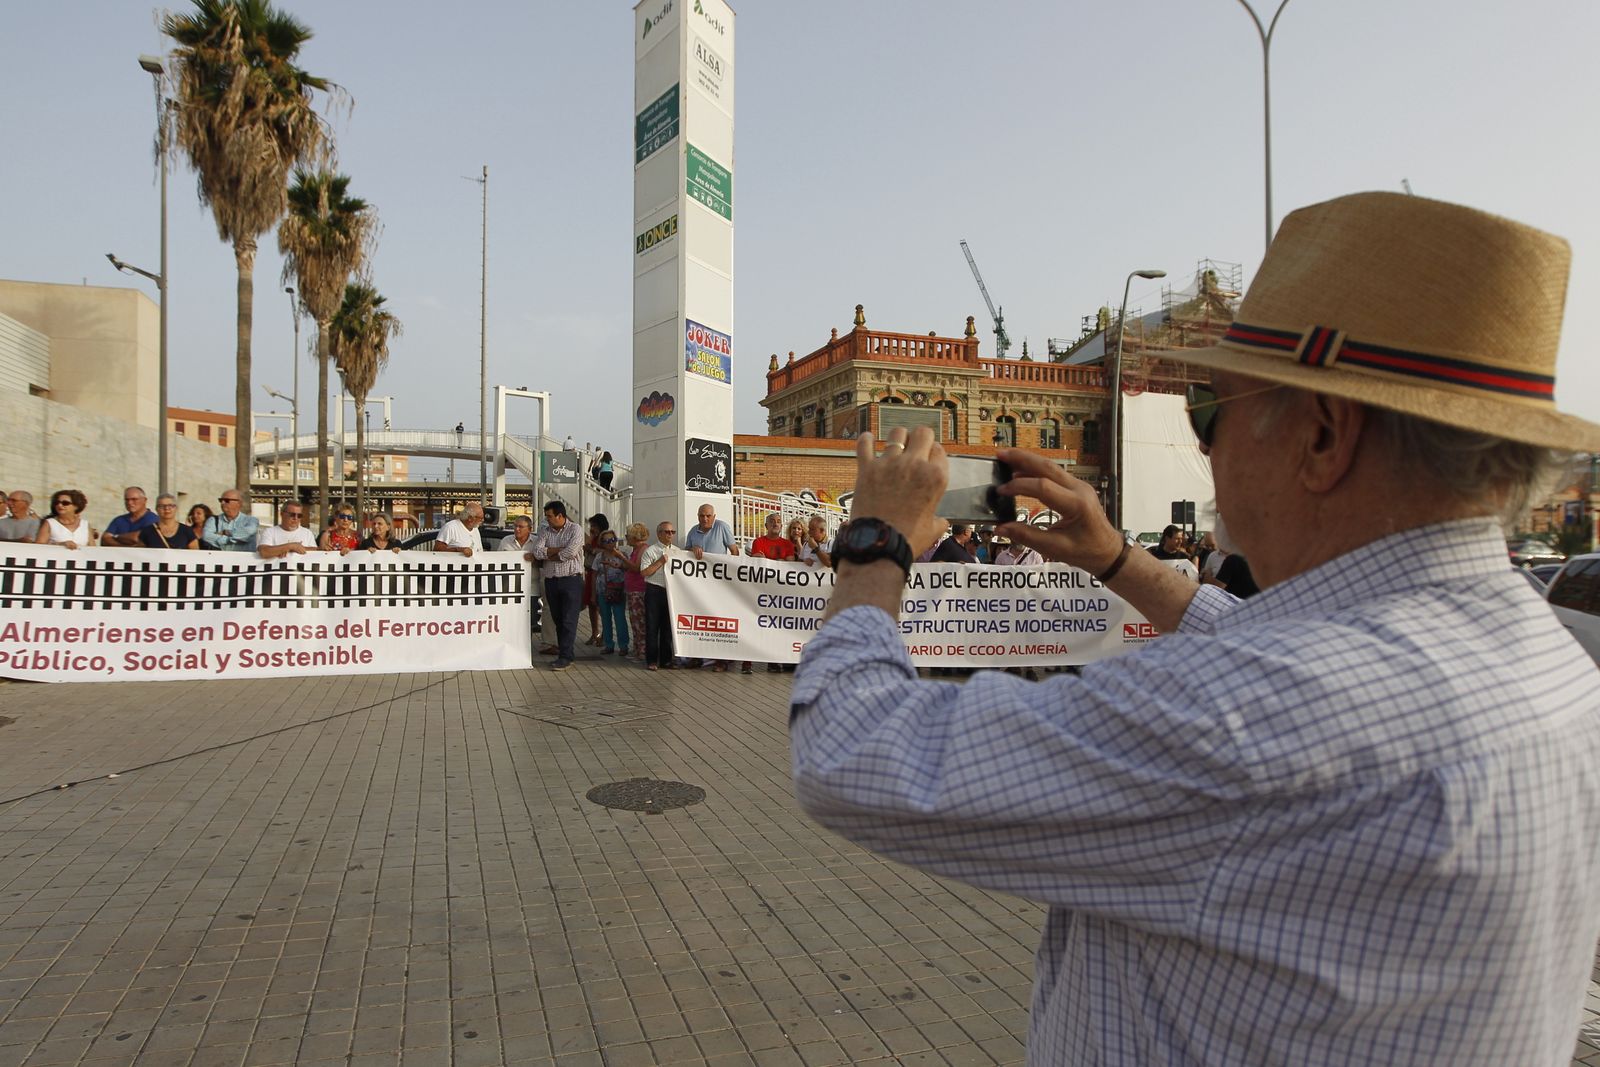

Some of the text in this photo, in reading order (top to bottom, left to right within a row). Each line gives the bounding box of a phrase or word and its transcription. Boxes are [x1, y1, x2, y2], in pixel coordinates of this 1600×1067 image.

[704, 13, 725, 36] adif
[696, 44, 721, 76] ALSA
[646, 214, 678, 250] ONCE
[687, 324, 731, 356] JOKER
[702, 364, 725, 381] JUEGO
[552, 458, 558, 466] P
[670, 558, 707, 579] POR
[712, 563, 733, 581] EL
[737, 565, 810, 587] EMPLEO
[814, 571, 826, 588] Y
[930, 572, 962, 590] DEL
[967, 571, 1085, 589] FERROCARRIL
[757, 594, 830, 611] EXIGIMO
[932, 599, 942, 612] Y
[946, 599, 1011, 613] TRENES
[1015, 599, 1036, 612] DE
[1041, 598, 1109, 612] CALIDAD
[0, 615, 500, 643] Almeriense en Defensa del Ferrocarril
[696, 618, 736, 630] CCOO
[757, 614, 824, 631] EXIGIMO
[1015, 619, 1107, 633] MODERNAS
[947, 645, 965, 656] DE
[969, 645, 1006, 656] CCOO
[1008, 641, 1068, 655] ALMERÍA
[123, 649, 208, 672] Social
[215, 652, 232, 674] y
[238, 645, 374, 669] Sostenible
